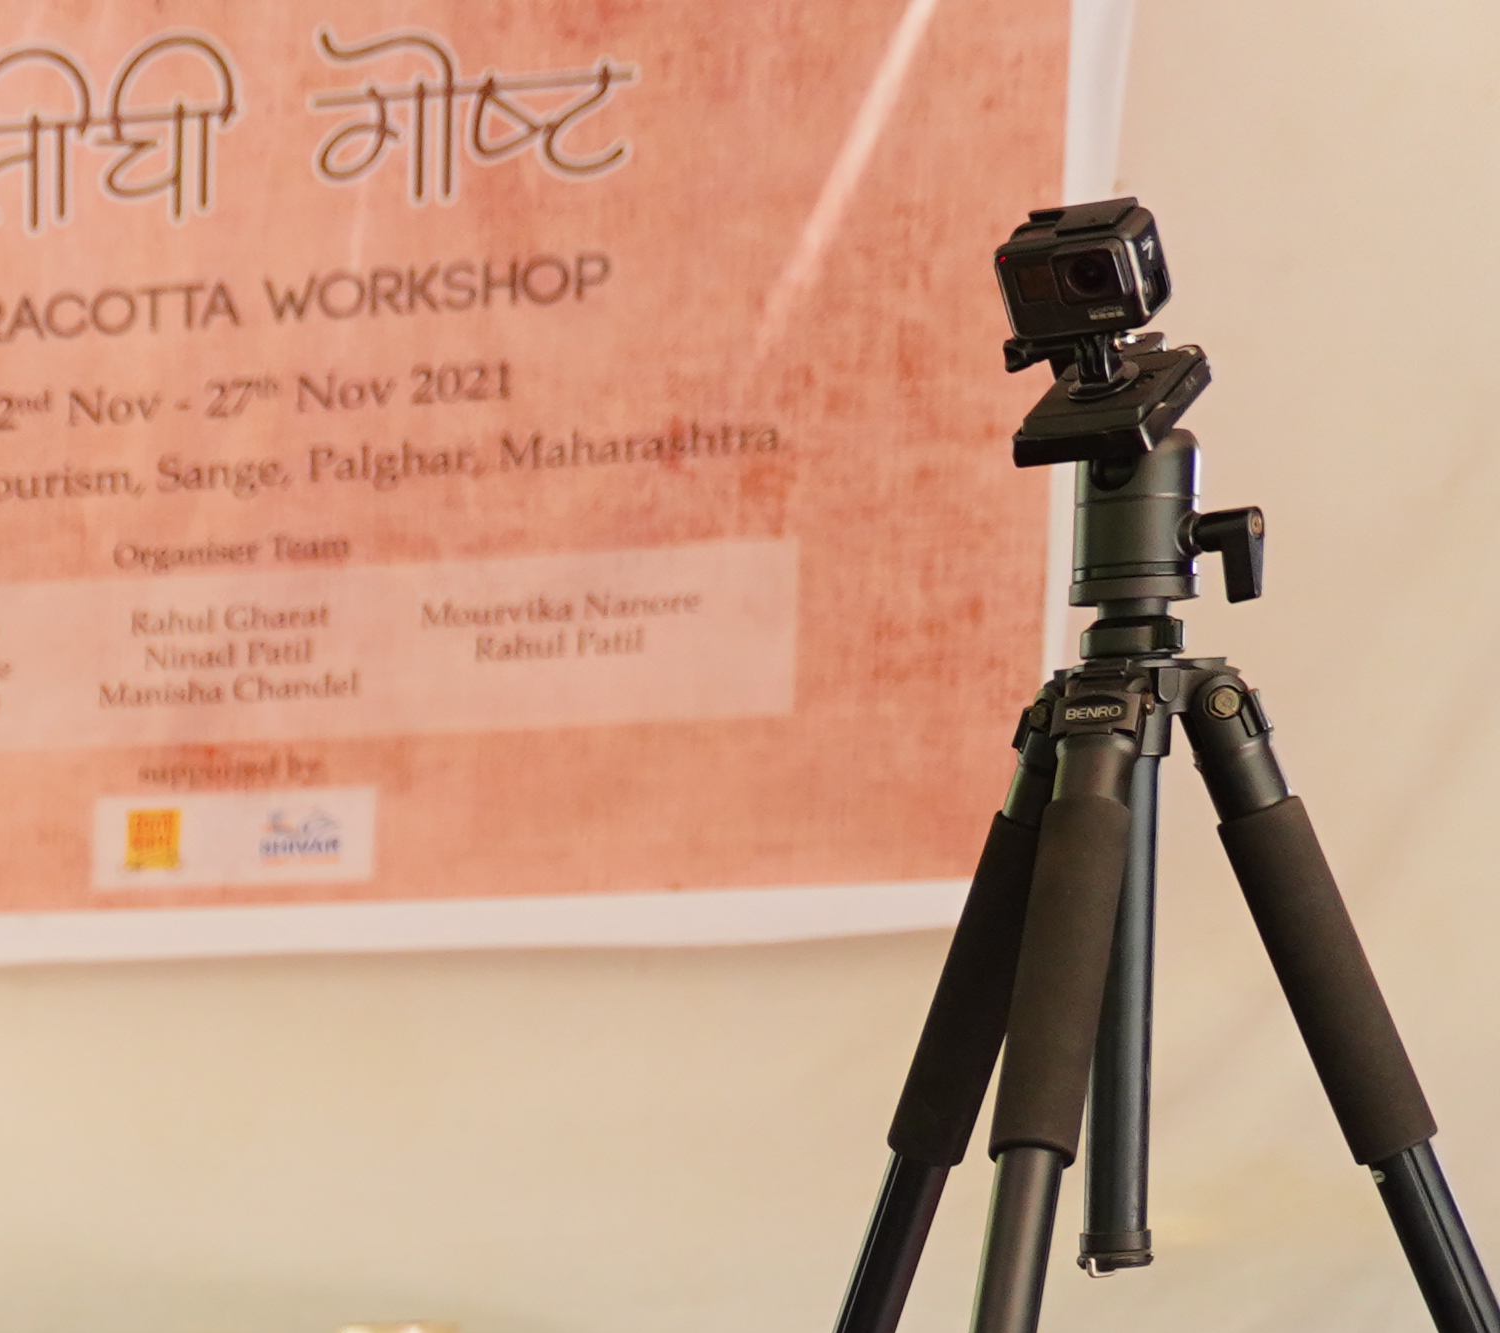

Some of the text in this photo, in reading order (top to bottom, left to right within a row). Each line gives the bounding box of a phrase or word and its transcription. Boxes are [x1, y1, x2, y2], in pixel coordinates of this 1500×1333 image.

[263, 252, 611, 323] WORKSHOP
[68, 387, 162, 427] Nov
[296, 372, 398, 414] Nov
[409, 359, 513, 404] 2021
[156, 452, 292, 499] Sange,
[309, 437, 487, 491] Palghar,
[112, 533, 350, 573] Organiser Team
[129, 604, 330, 637] Rahul Gharat
[144, 638, 315, 671] Ninad Patil
[475, 625, 646, 662] Rahul Patil
[98, 671, 361, 708] Manisha Chandel
[1065, 705, 1123, 720] BENRO
